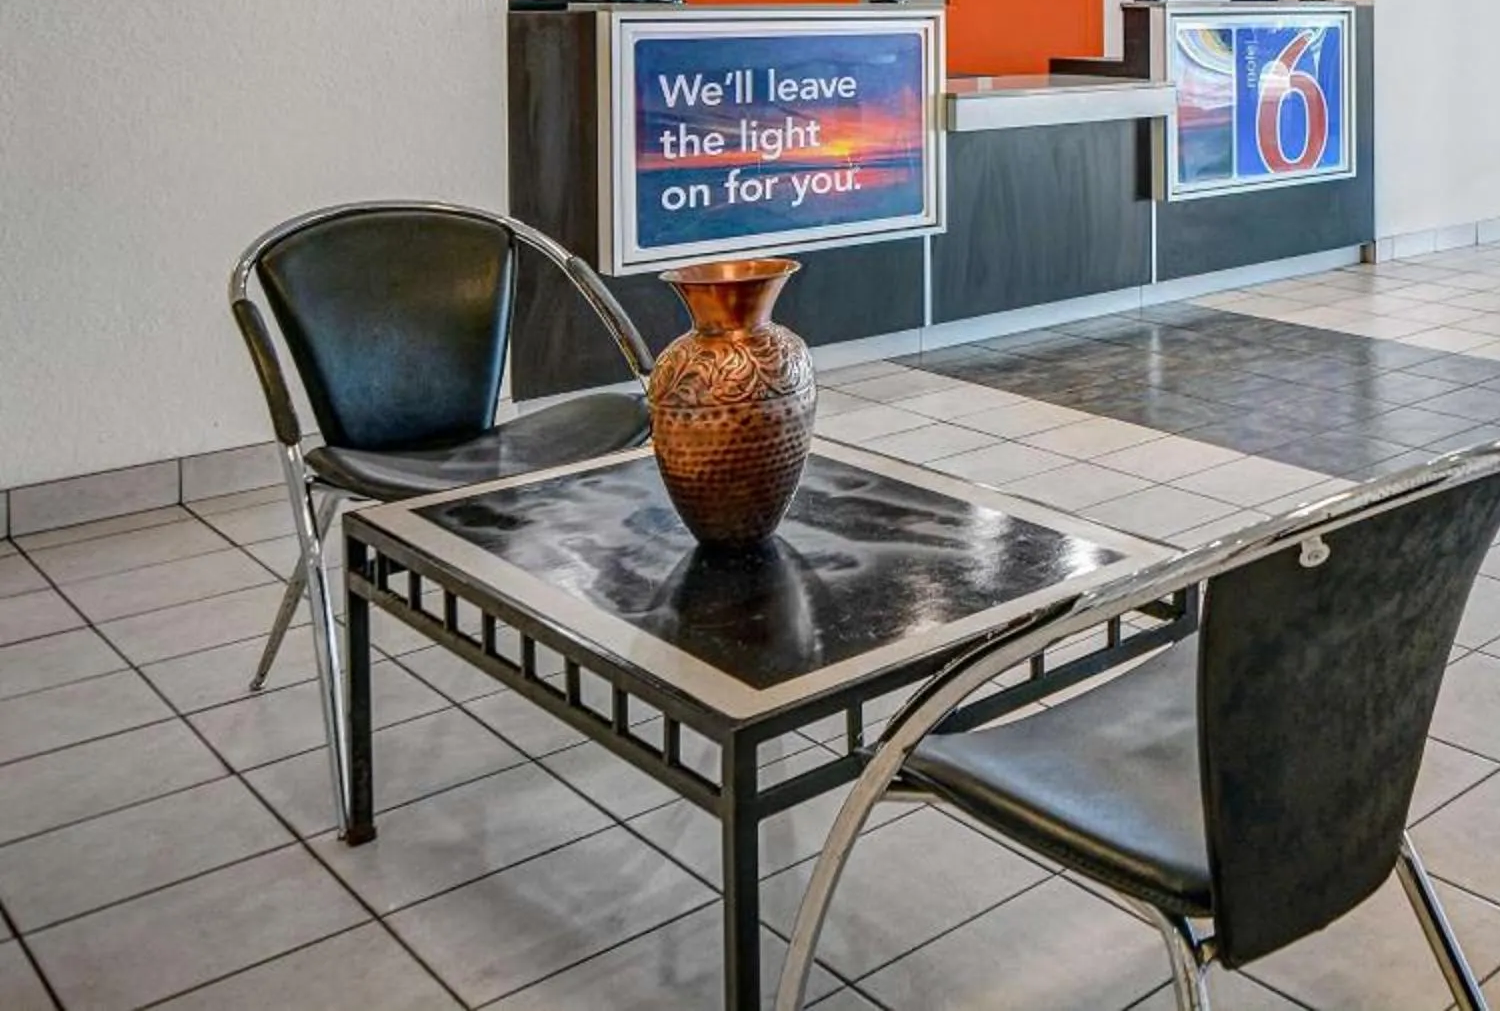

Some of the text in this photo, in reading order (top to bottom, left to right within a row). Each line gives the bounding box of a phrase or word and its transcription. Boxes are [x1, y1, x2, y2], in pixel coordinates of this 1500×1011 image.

[768, 68, 857, 102] leave
[1256, 28, 1329, 173] 6
[659, 117, 821, 161] the light
[661, 168, 862, 211] on for you.
